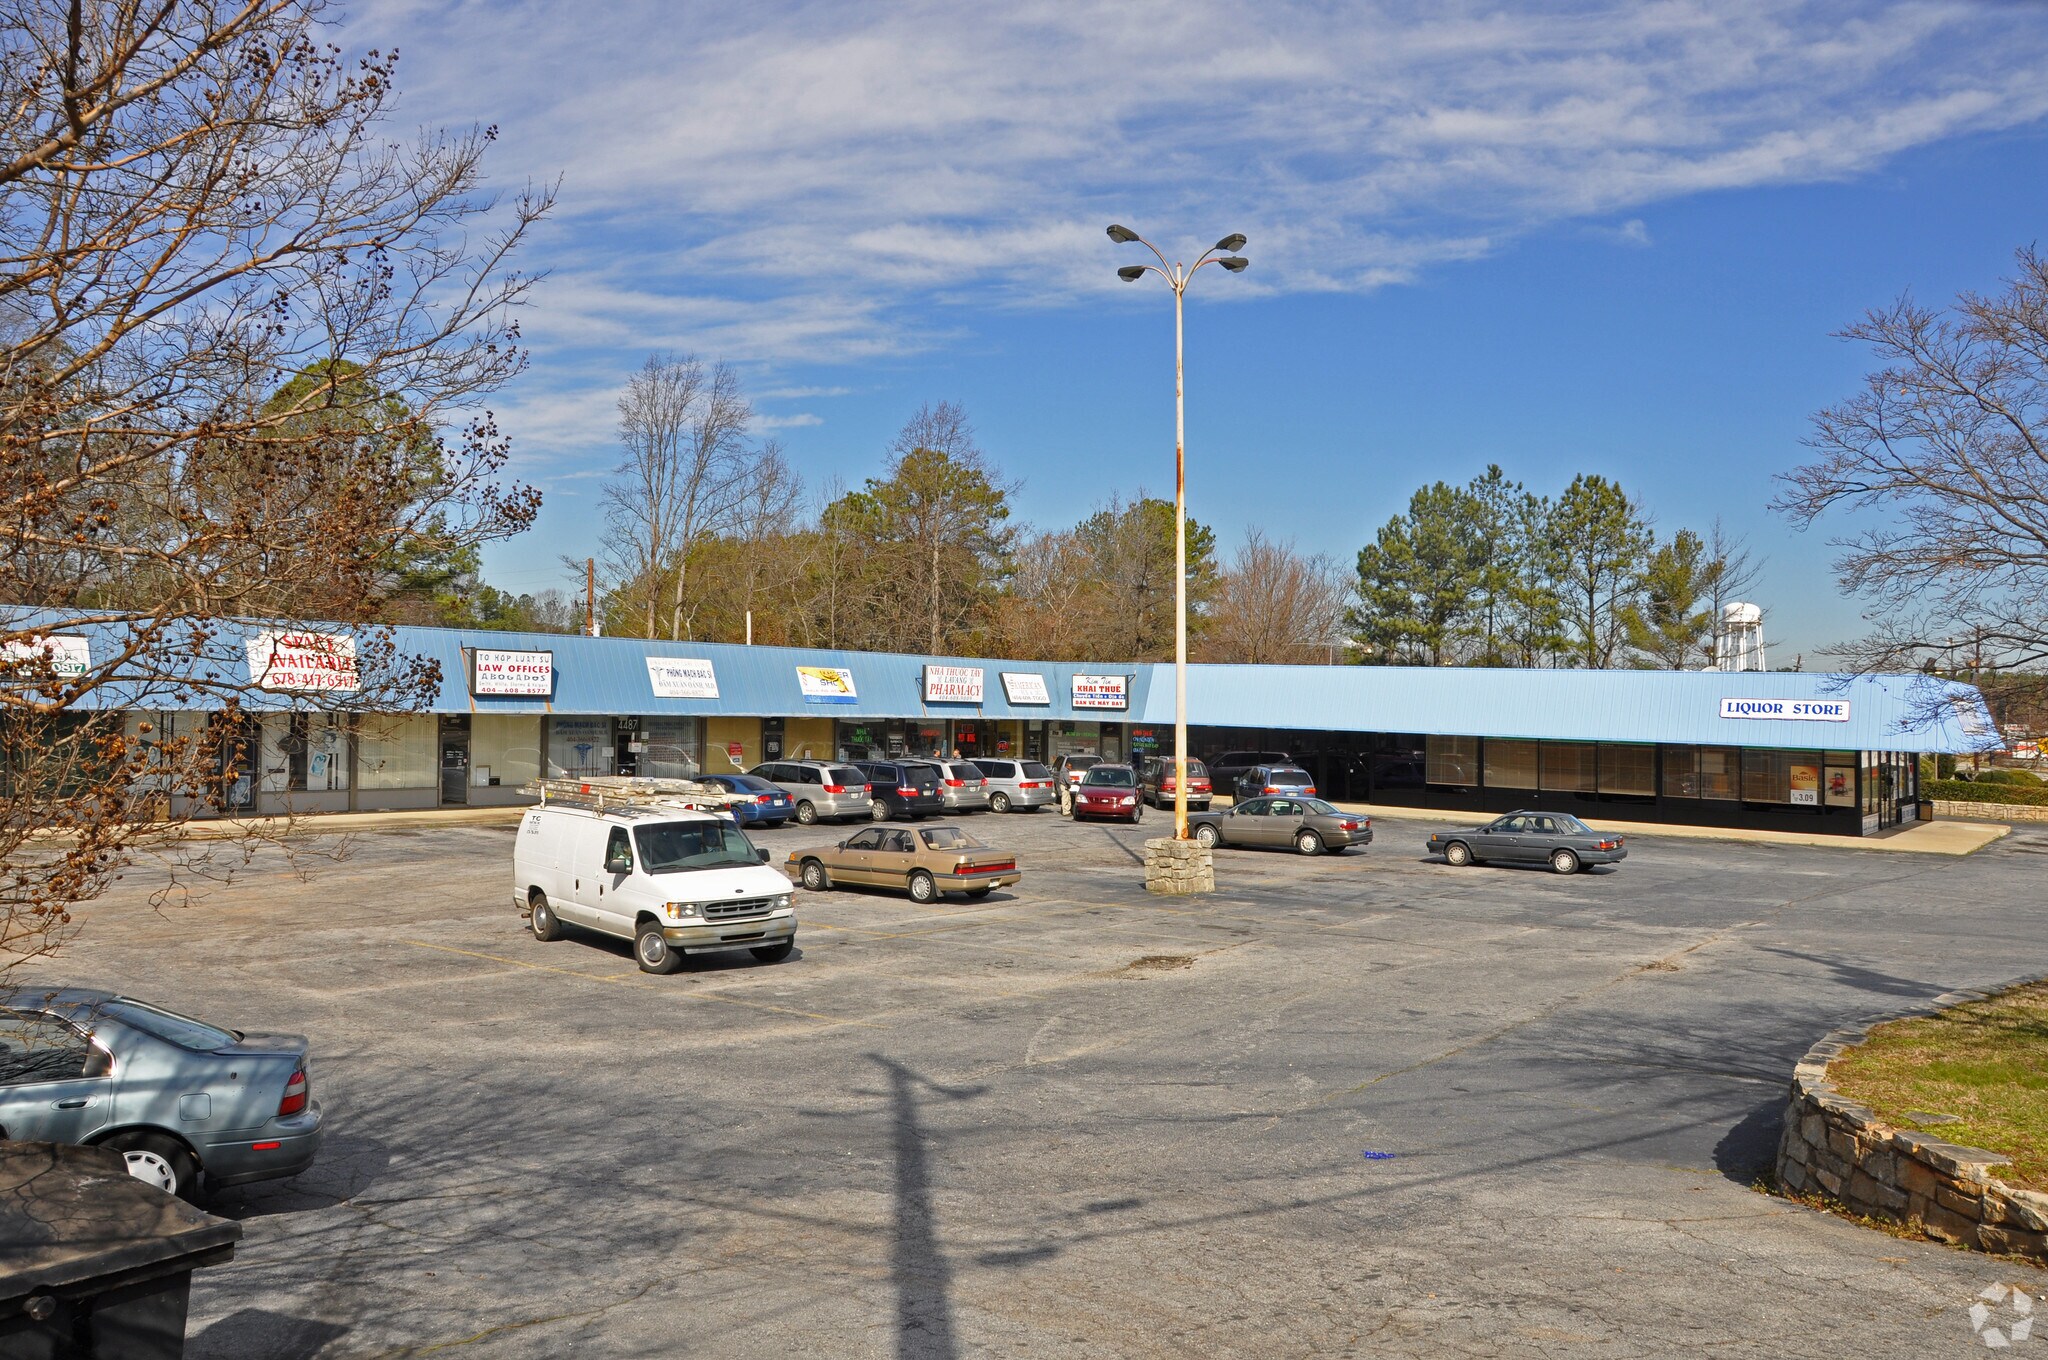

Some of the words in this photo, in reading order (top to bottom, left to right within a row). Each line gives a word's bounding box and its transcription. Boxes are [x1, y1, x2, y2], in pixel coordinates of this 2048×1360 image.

[51, 662, 84, 672] 0817
[478, 664, 502, 672] LAW
[508, 665, 550, 674] OFFICES
[481, 673, 546, 681] ABOGADOS
[929, 684, 982, 696] PHARMACY
[1727, 702, 1783, 715] LIQUOR
[1792, 704, 1843, 716] STORE
[618, 720, 638, 730] 4487
[1798, 794, 1814, 802] 3.09
